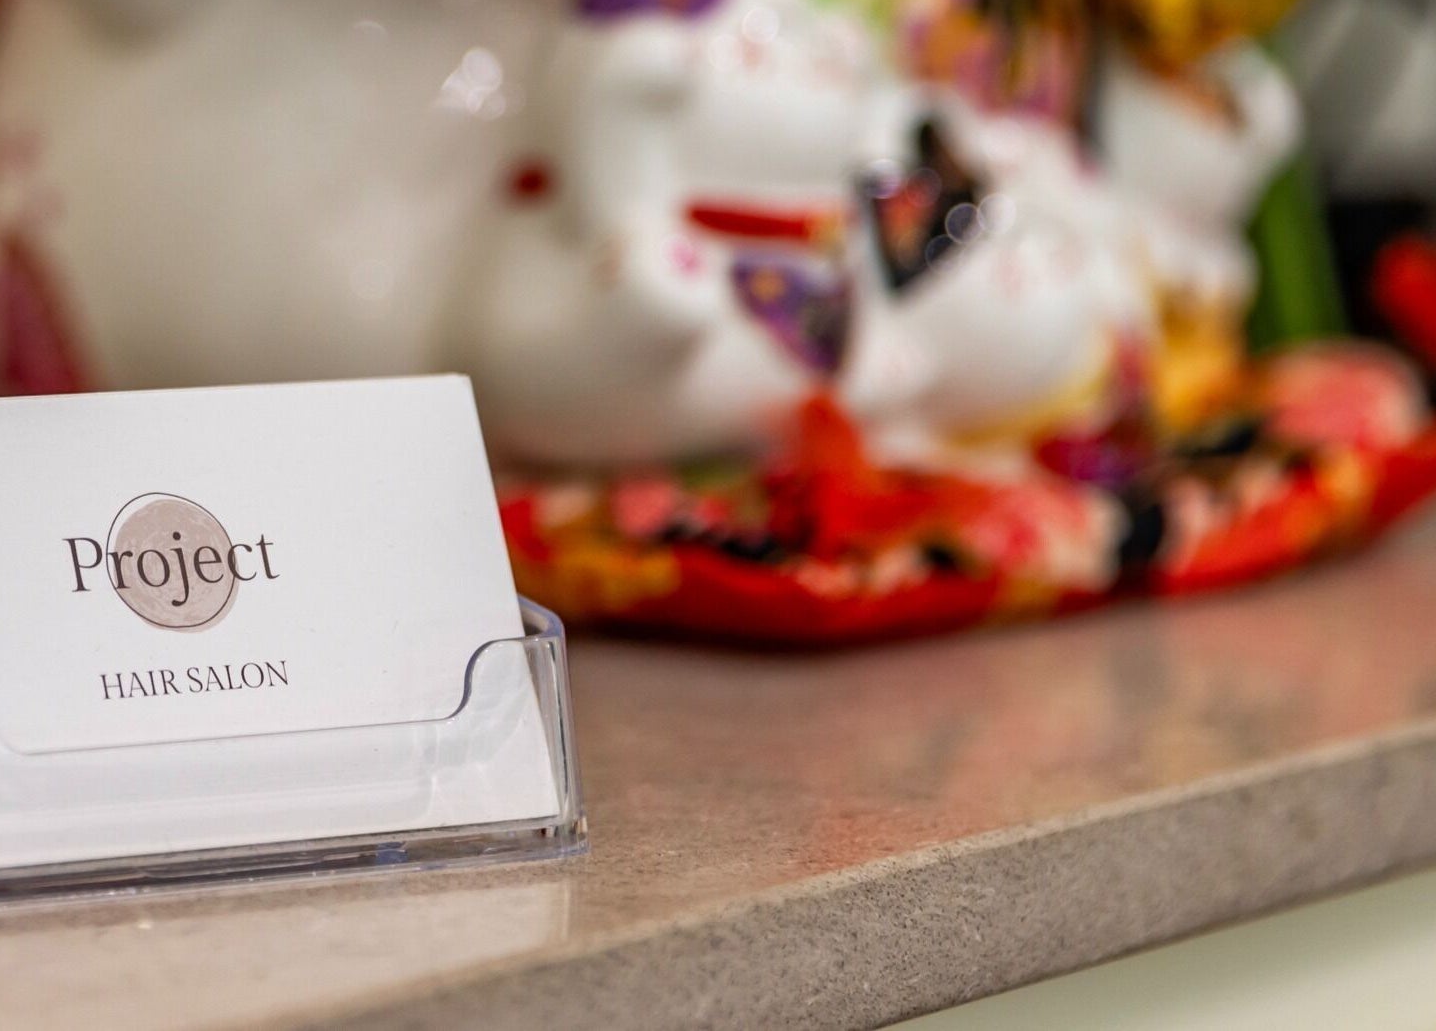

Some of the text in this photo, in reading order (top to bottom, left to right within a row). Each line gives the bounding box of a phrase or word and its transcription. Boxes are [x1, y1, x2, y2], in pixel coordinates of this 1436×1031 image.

[62, 530, 280, 607] Project
[99, 660, 289, 700] HAIR SALON
